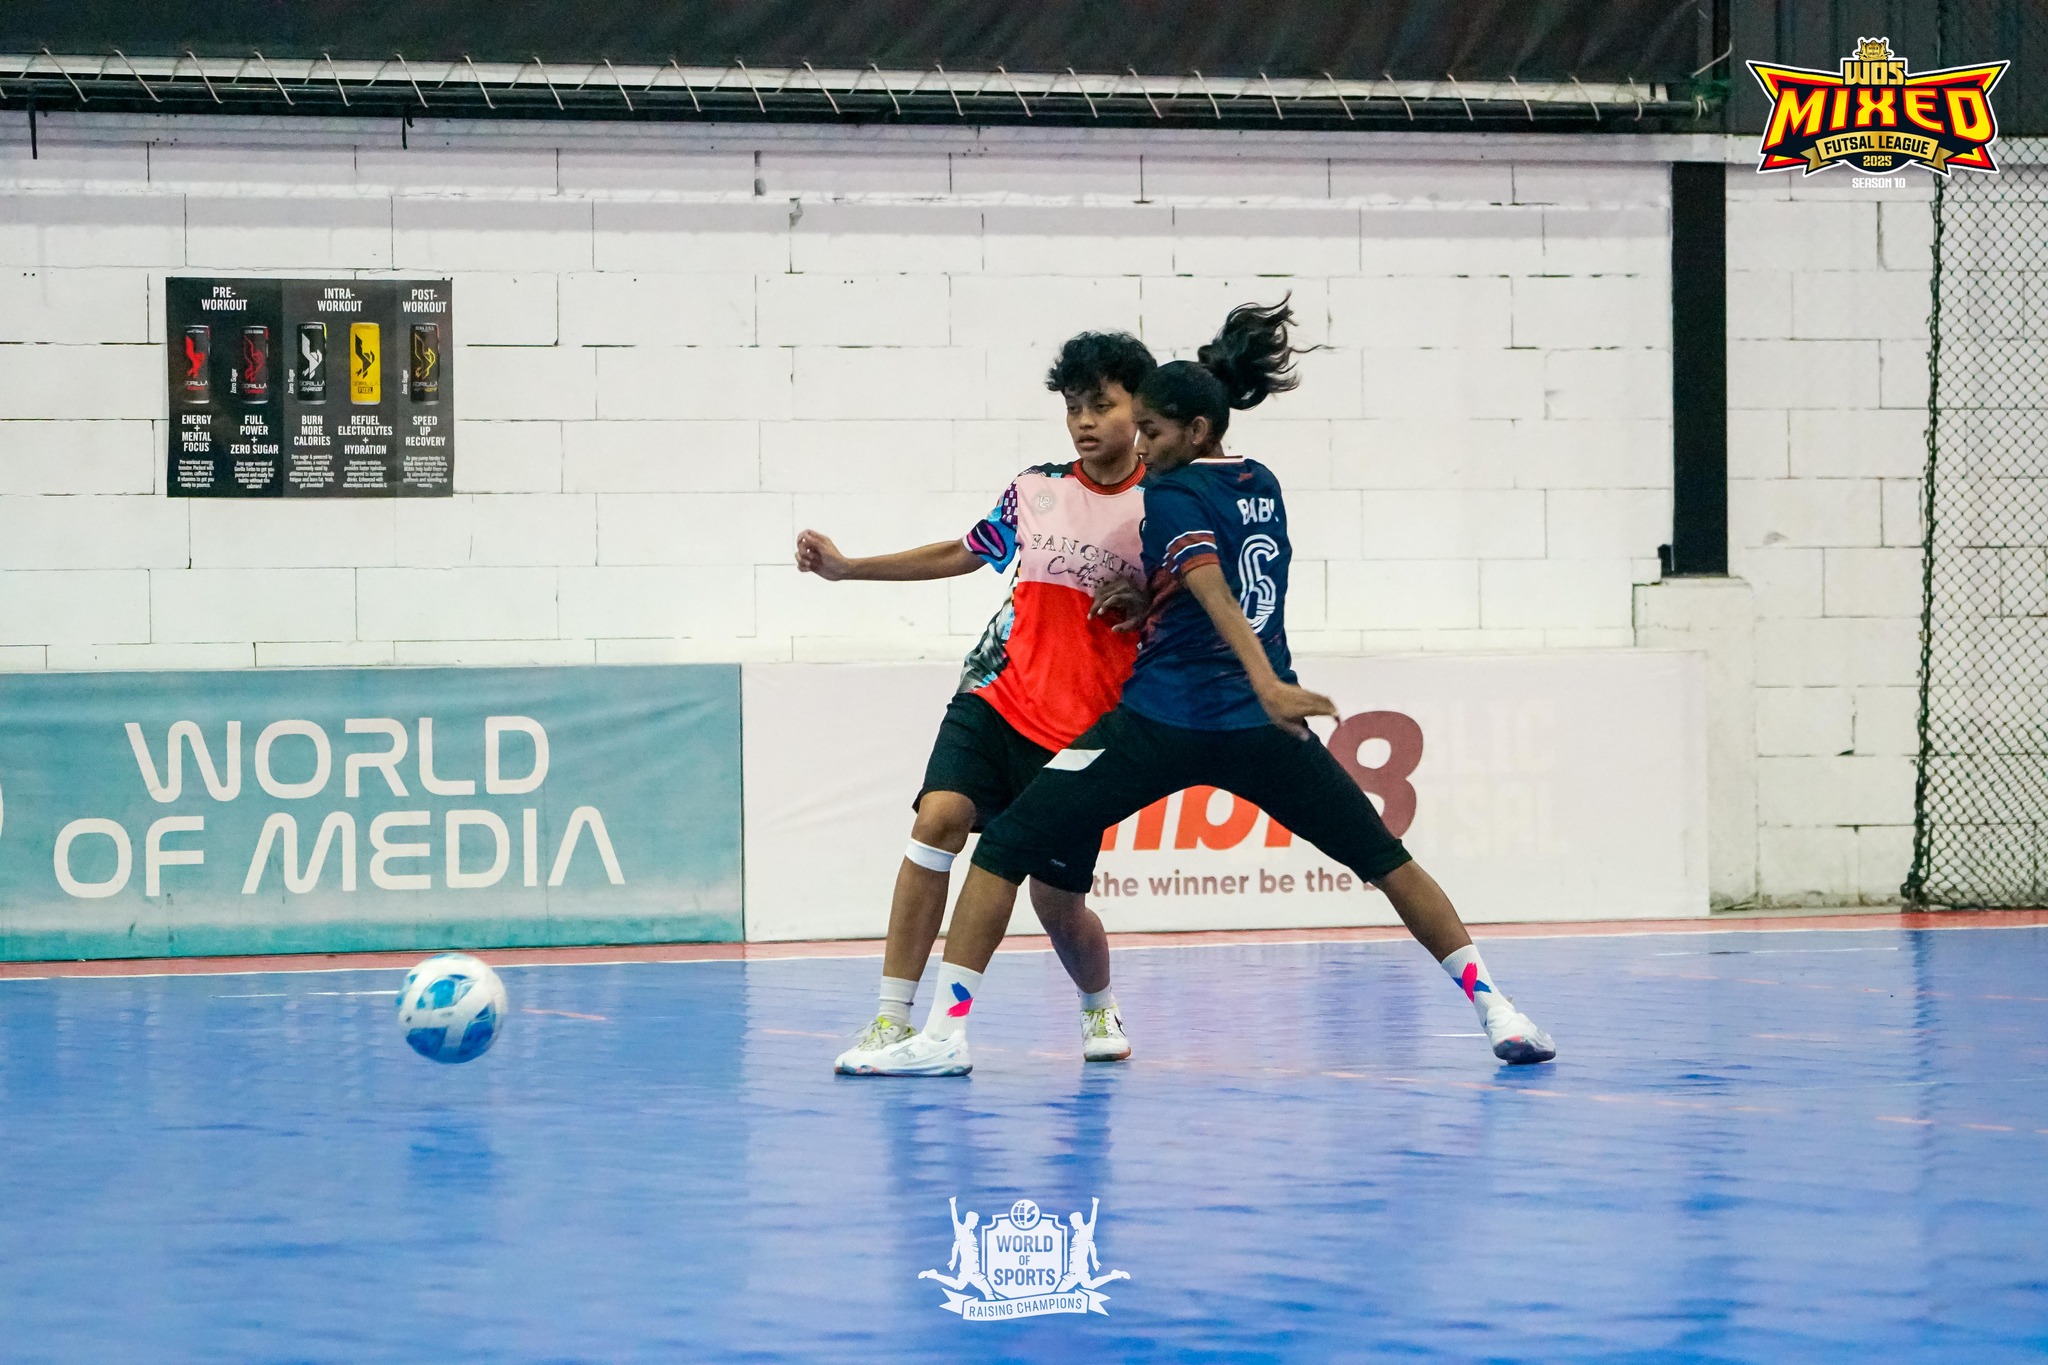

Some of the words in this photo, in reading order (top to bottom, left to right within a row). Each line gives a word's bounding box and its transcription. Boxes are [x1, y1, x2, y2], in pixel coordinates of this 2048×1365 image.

[213, 287, 236, 299] PRE-
[324, 288, 355, 300] INTRA-
[412, 289, 438, 300] POST-
[202, 299, 247, 311] WORKOUT
[318, 300, 362, 312] WORKOUT
[403, 301, 446, 313] WORKOUT
[182, 415, 211, 424] ENERGY
[244, 415, 264, 424] FULL
[302, 416, 323, 424] BURN
[351, 416, 380, 425] REFUEL
[412, 416, 437, 426] SPEED
[240, 426, 268, 435] POWER
[301, 426, 323, 435] MORE
[338, 426, 392, 436] ELECTROLYTES
[420, 426, 430, 436] UP
[182, 431, 211, 442] MENTAL
[294, 436, 330, 446] CALORIES
[406, 436, 446, 446] RECOVERY
[184, 442, 209, 452] FOCUS
[230, 444, 251, 454] ZERO
[252, 444, 278, 454] SUGAR
[344, 444, 386, 454] HYDRATION
[1238, 534, 1280, 634] 6
[125, 715, 550, 803] WORLD
[53, 816, 204, 899] OF
[241, 806, 625, 893] MEDIA
[1093, 872, 1139, 897] the
[1150, 869, 1249, 896] winner
[1260, 869, 1295, 894] be
[1306, 868, 1352, 893] the
